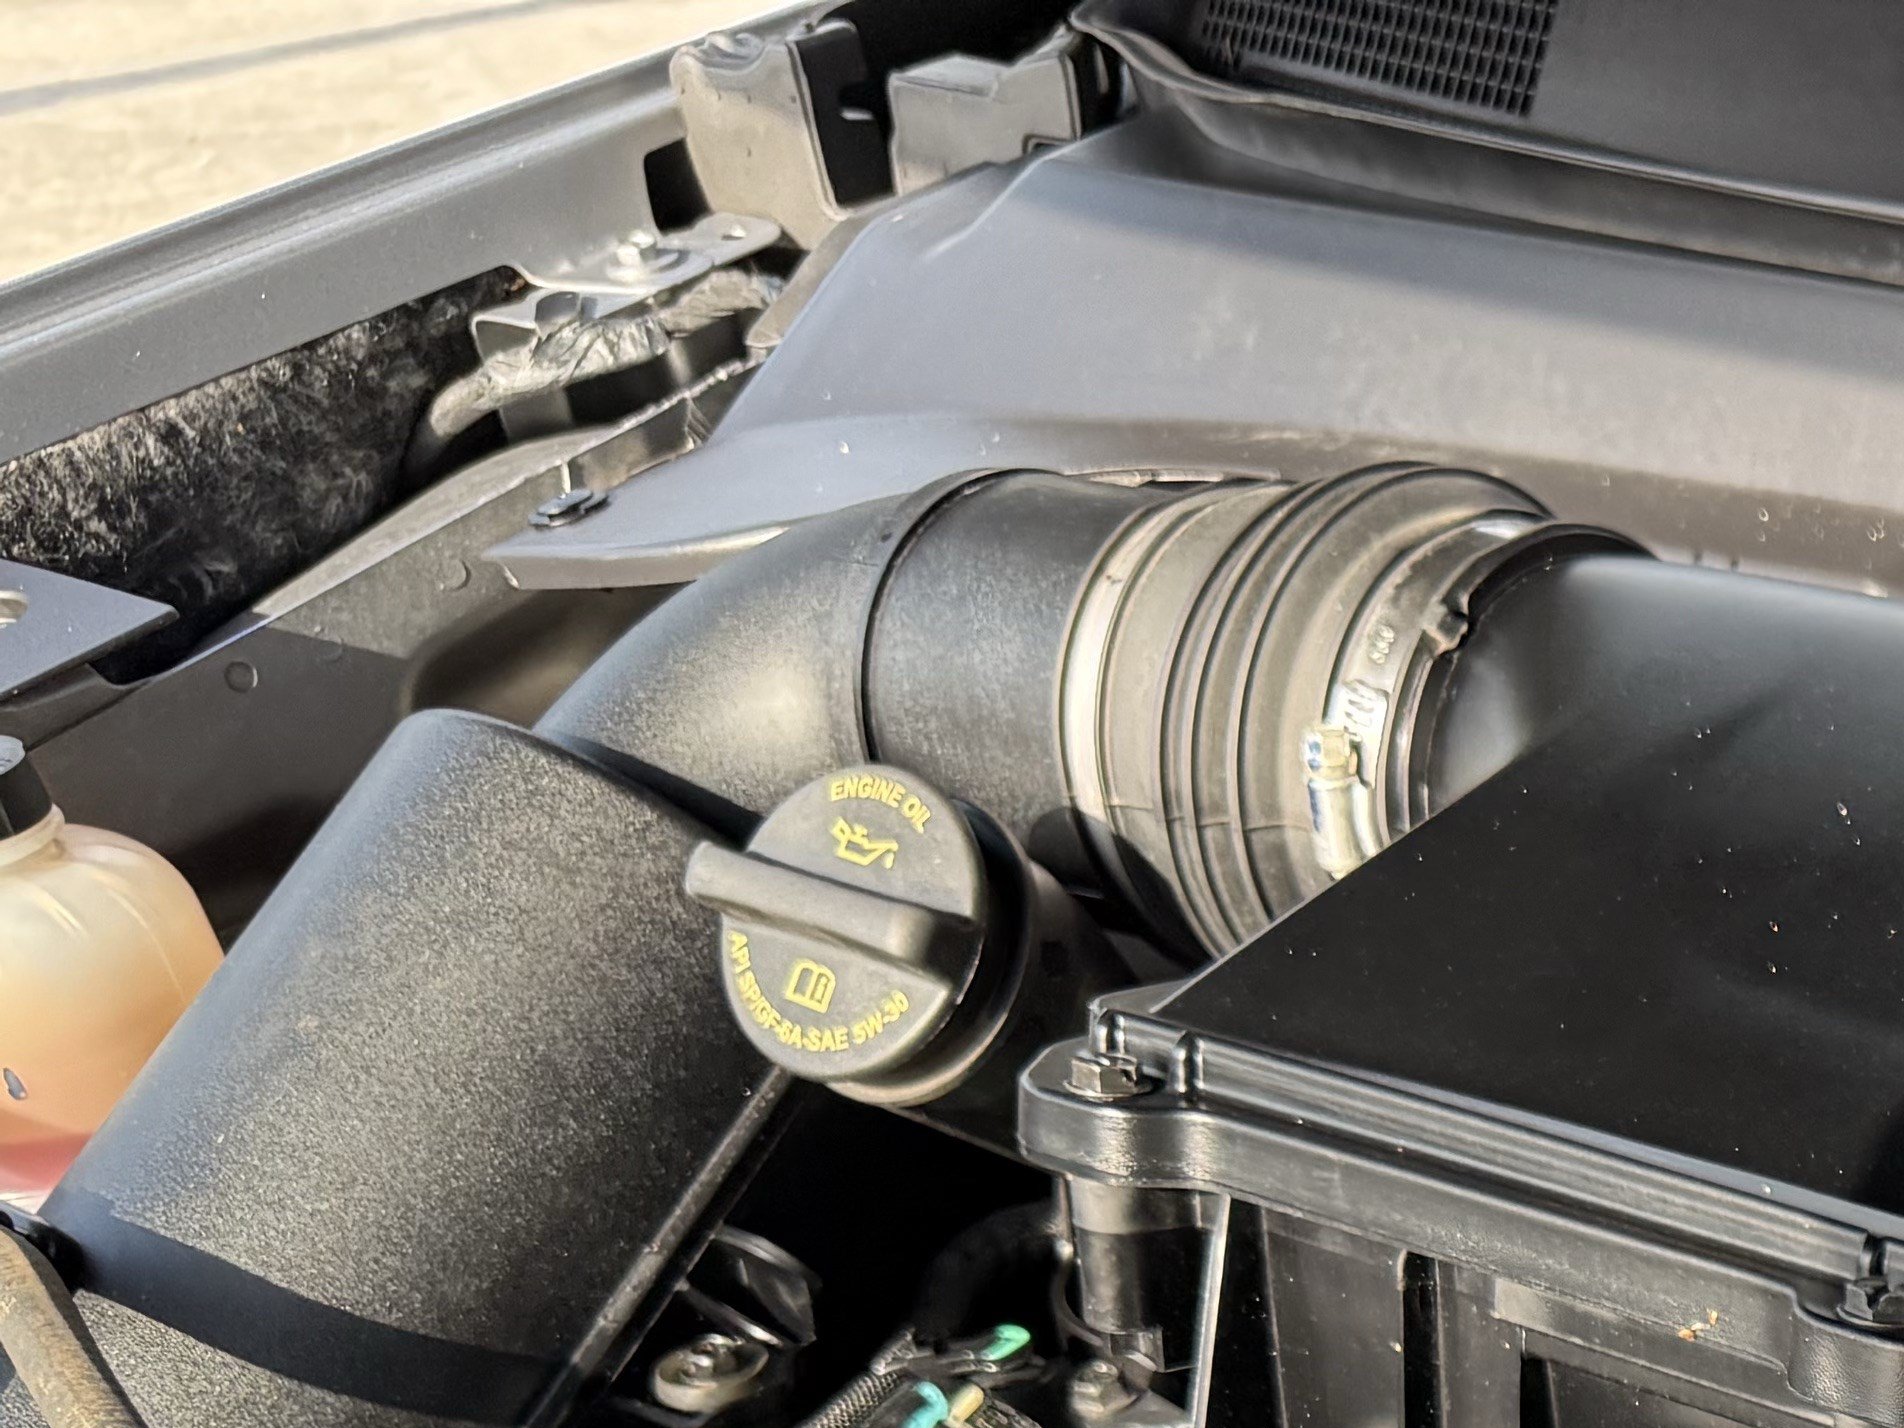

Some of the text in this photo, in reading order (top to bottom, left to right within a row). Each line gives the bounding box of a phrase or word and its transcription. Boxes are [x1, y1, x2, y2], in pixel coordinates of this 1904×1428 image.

[831, 774, 931, 834] ENGINE OIL
[851, 989, 909, 1045] 5W-30
